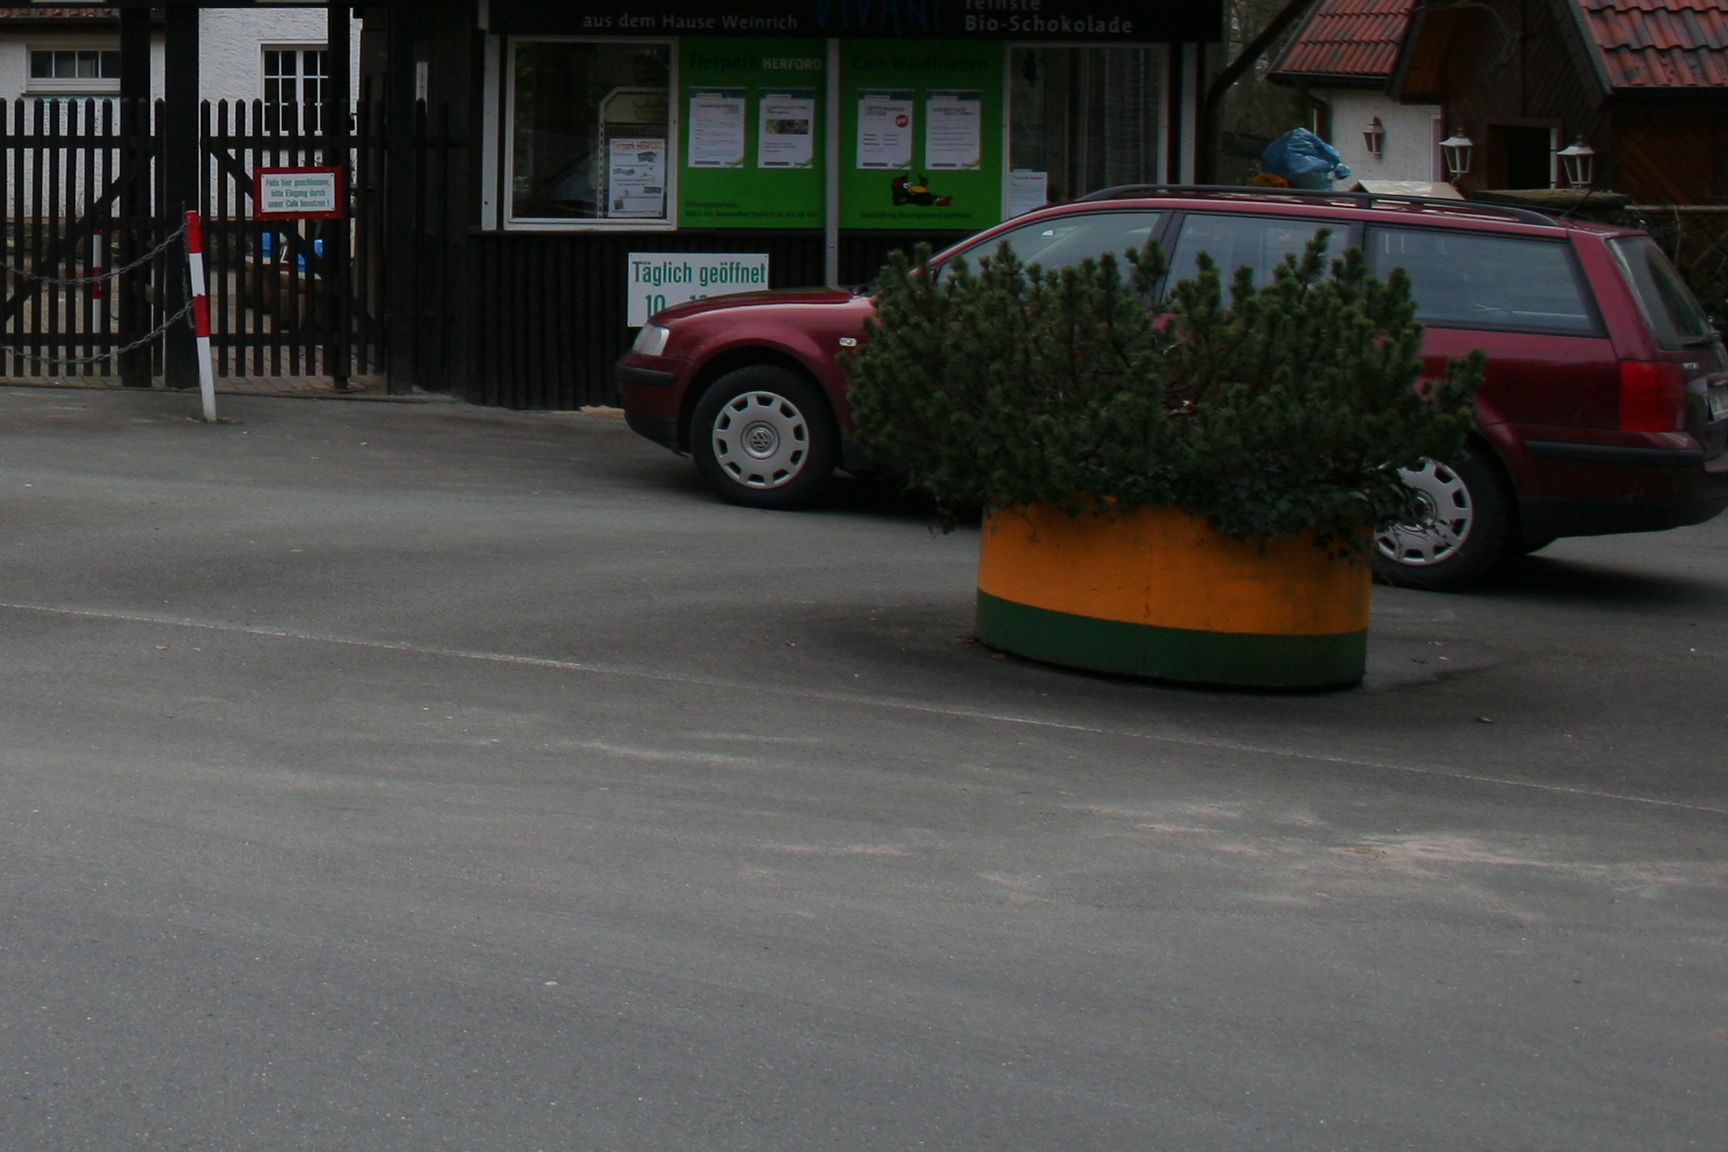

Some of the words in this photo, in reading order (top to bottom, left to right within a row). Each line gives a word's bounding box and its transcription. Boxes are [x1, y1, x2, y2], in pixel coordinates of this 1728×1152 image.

[582, 15, 615, 29] aus
[620, 12, 656, 29] dem
[662, 12, 715, 30] Hause
[721, 12, 798, 31] Weinrich
[964, 14, 1133, 33] Bio-Schokolade
[689, 52, 757, 72] Tierpark
[762, 57, 821, 70] HERFORD
[632, 261, 692, 286] Täglich
[699, 261, 766, 286] geöffnet
[645, 294, 666, 319] 10
